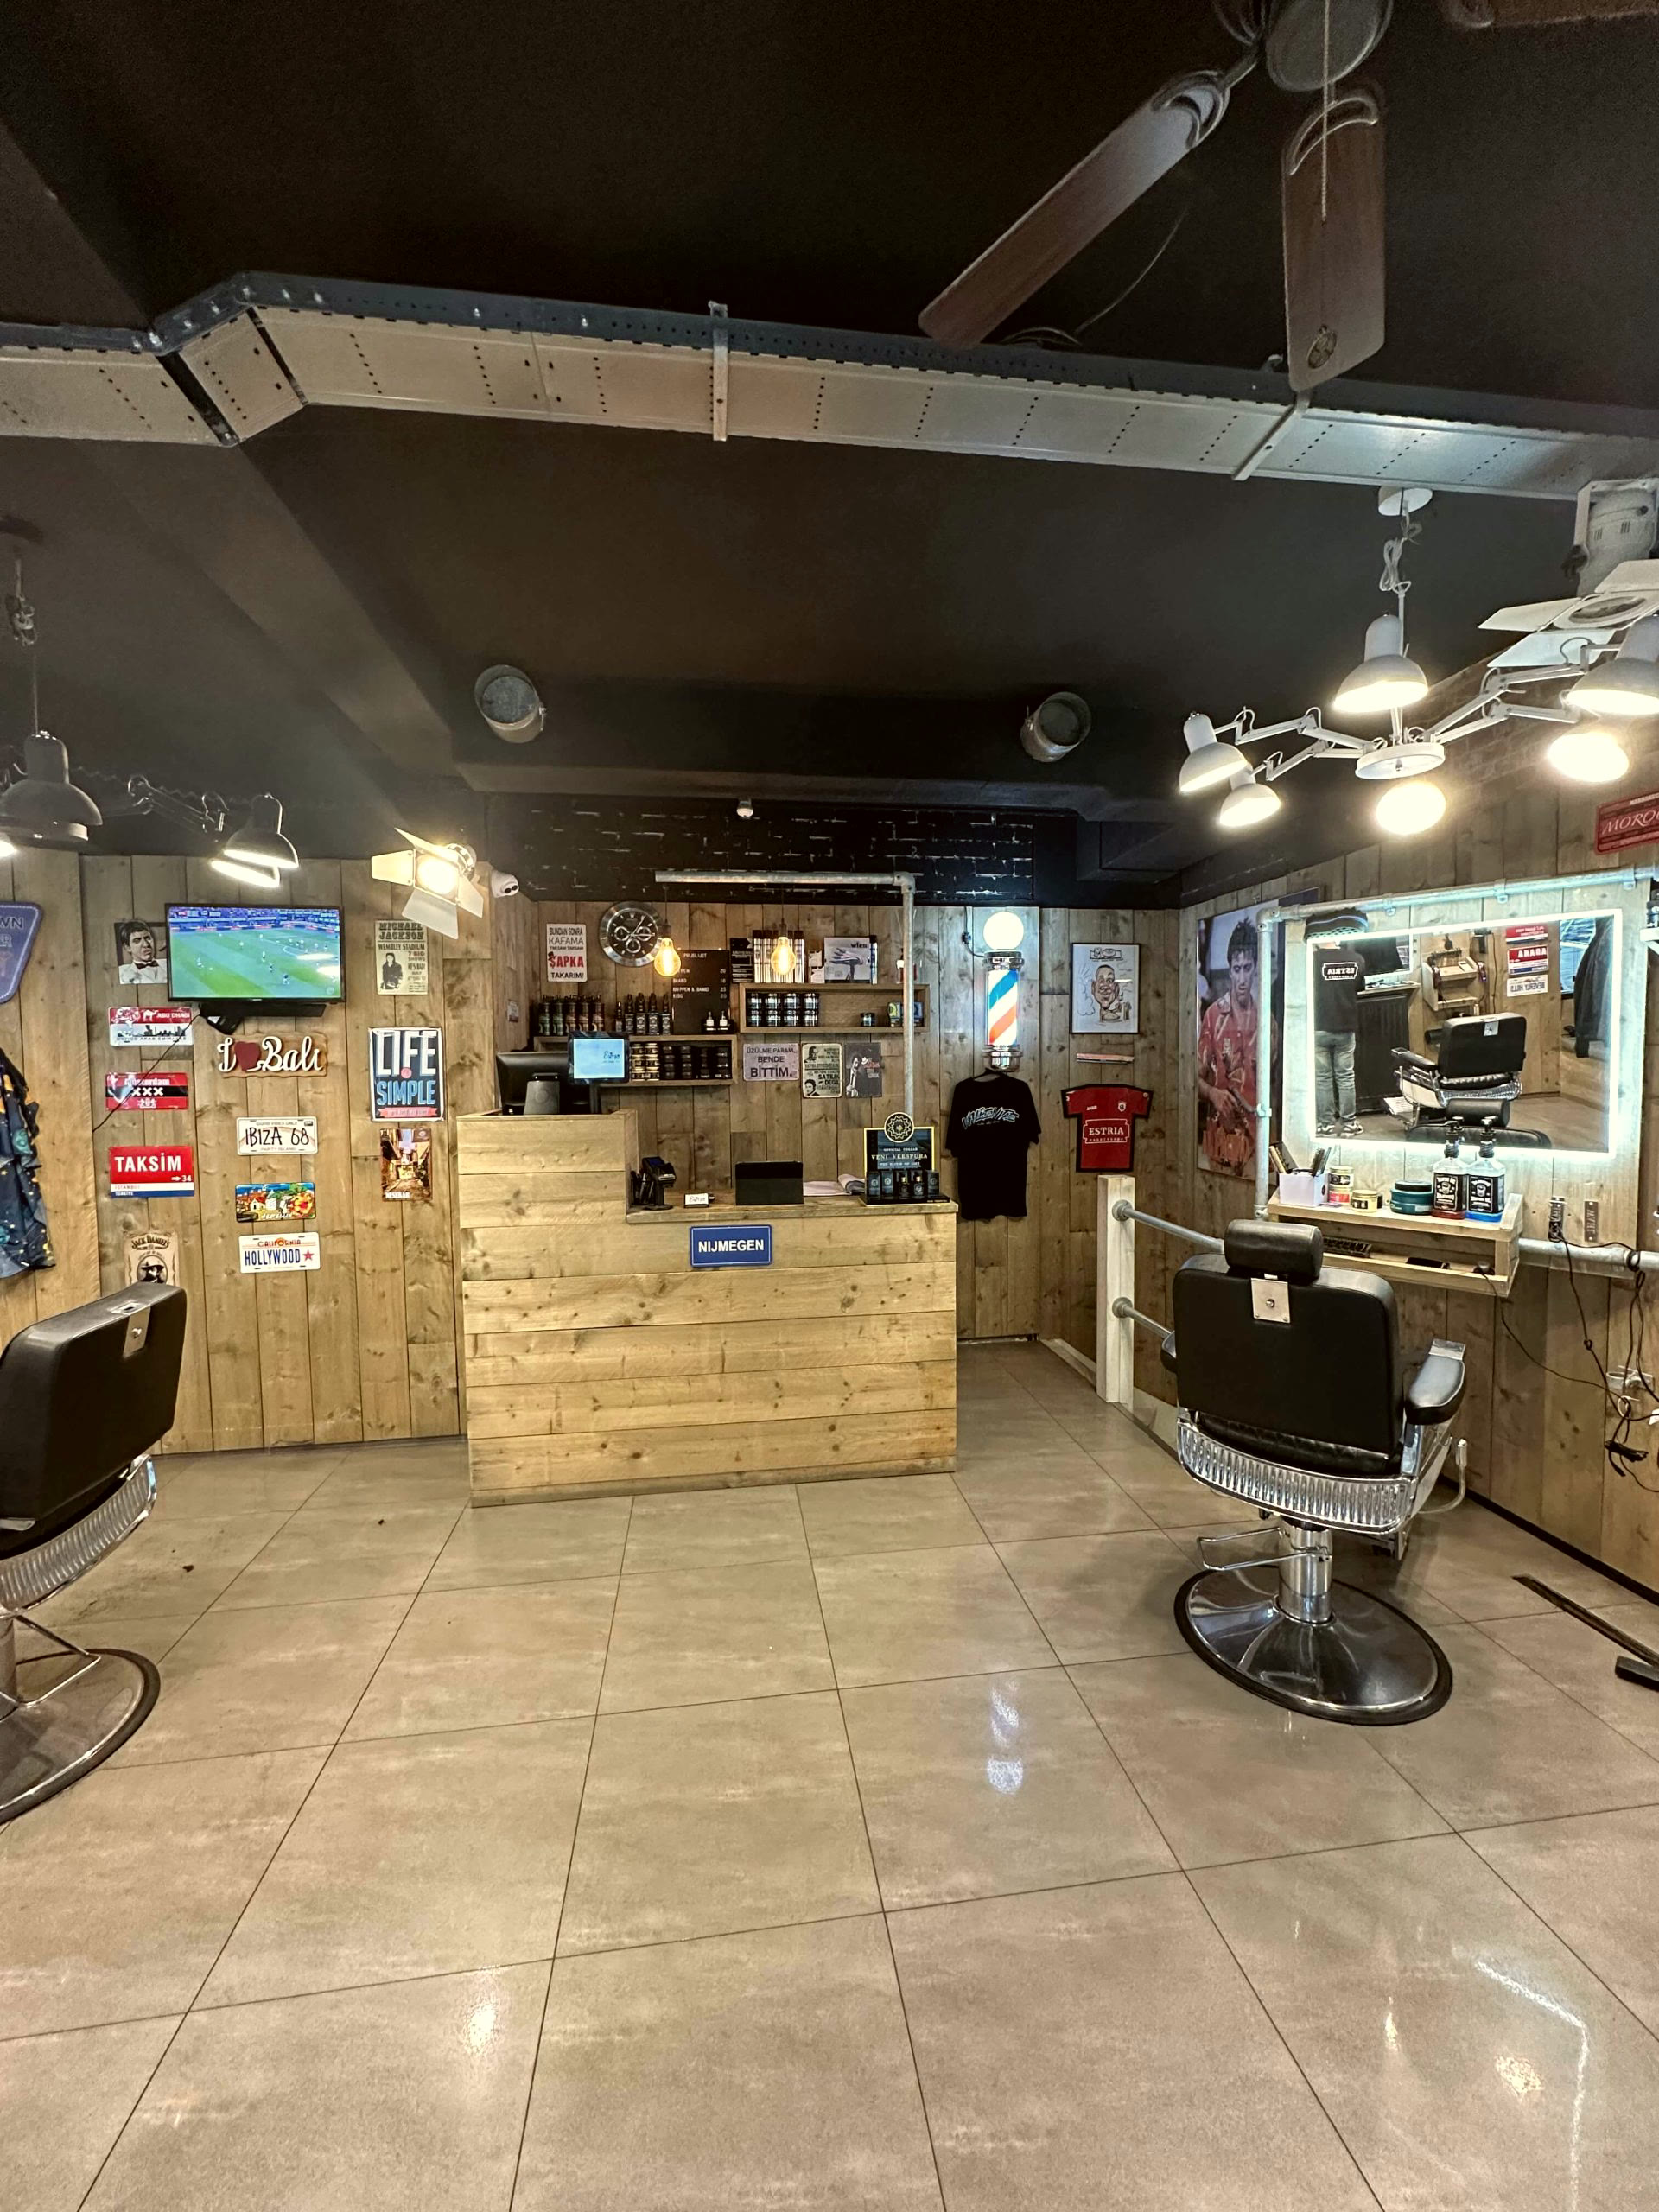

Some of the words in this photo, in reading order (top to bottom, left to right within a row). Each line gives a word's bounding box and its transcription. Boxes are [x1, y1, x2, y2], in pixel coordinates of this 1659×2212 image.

[1601, 810, 1659, 835] MORO
[379, 922, 423, 931] MICHAEL
[549, 927, 568, 936] BUNDAN
[549, 937, 584, 945] KAFAMA
[217, 1037, 237, 1072] I
[246, 1036, 323, 1072] Bali
[376, 1029, 437, 1077] LIFE
[376, 1080, 436, 1105] SIMPLE
[245, 1126, 283, 1147] IBIZA
[290, 1128, 309, 1146] 68
[1088, 1127, 1124, 1135] ESTRIA
[114, 1152, 181, 1172] TAKSİM
[698, 1239, 765, 1252] NIJMEGEN
[245, 1248, 301, 1266] HOLLYWOOD
